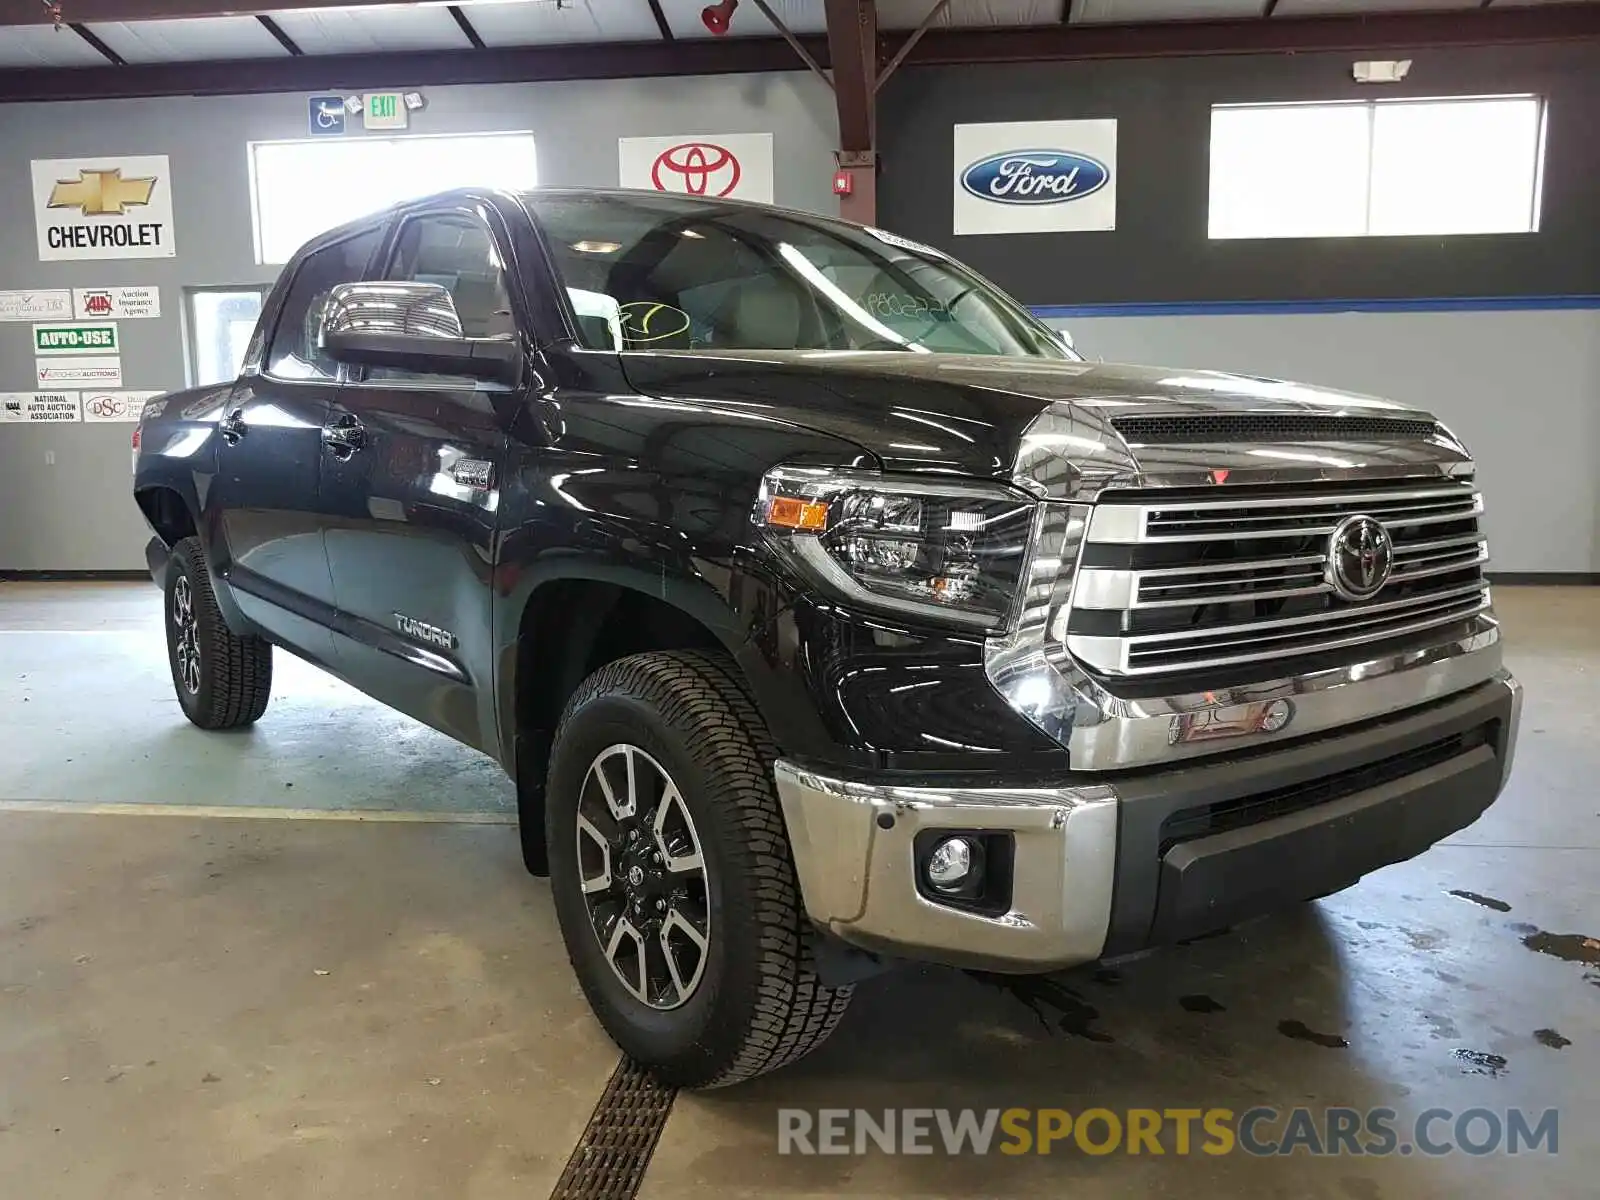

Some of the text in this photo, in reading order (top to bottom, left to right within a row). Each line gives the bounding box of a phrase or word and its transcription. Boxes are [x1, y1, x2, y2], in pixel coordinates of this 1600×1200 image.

[371, 95, 397, 117] EXIT
[990, 158, 1080, 196] Ford
[47, 223, 162, 248] CHEVROLET
[121, 290, 149, 298] Auction
[30, 412, 74, 420] ASSOCIATION
[46, 403, 76, 411] AUCTION
[394, 613, 452, 649] TUNDRA
